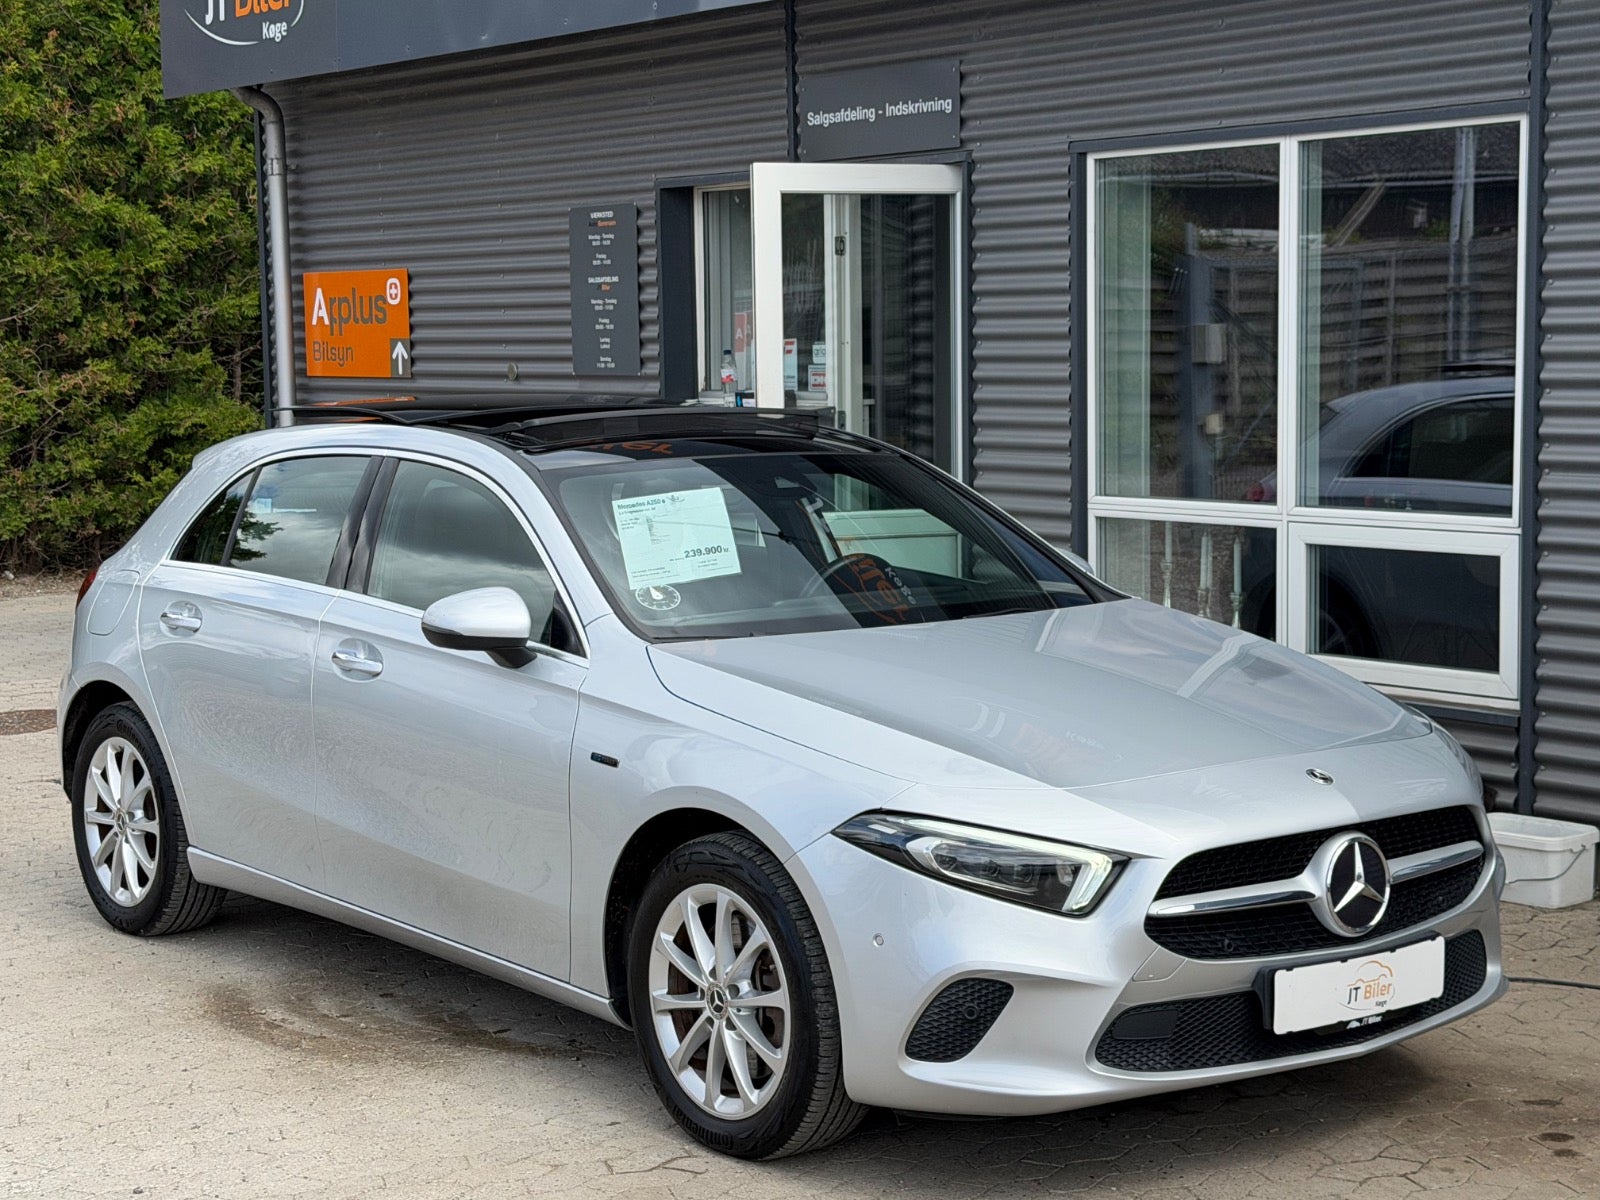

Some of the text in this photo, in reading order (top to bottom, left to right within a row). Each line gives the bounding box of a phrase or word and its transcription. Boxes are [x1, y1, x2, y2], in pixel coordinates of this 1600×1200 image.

[262, 21, 288, 42] Køge
[807, 106, 876, 127] Salgsafdeling
[886, 96, 952, 117] Indskrivning
[313, 341, 354, 367] Bilsyn
[684, 545, 723, 558] 239.900
[1347, 982, 1392, 1005] JT Biler
